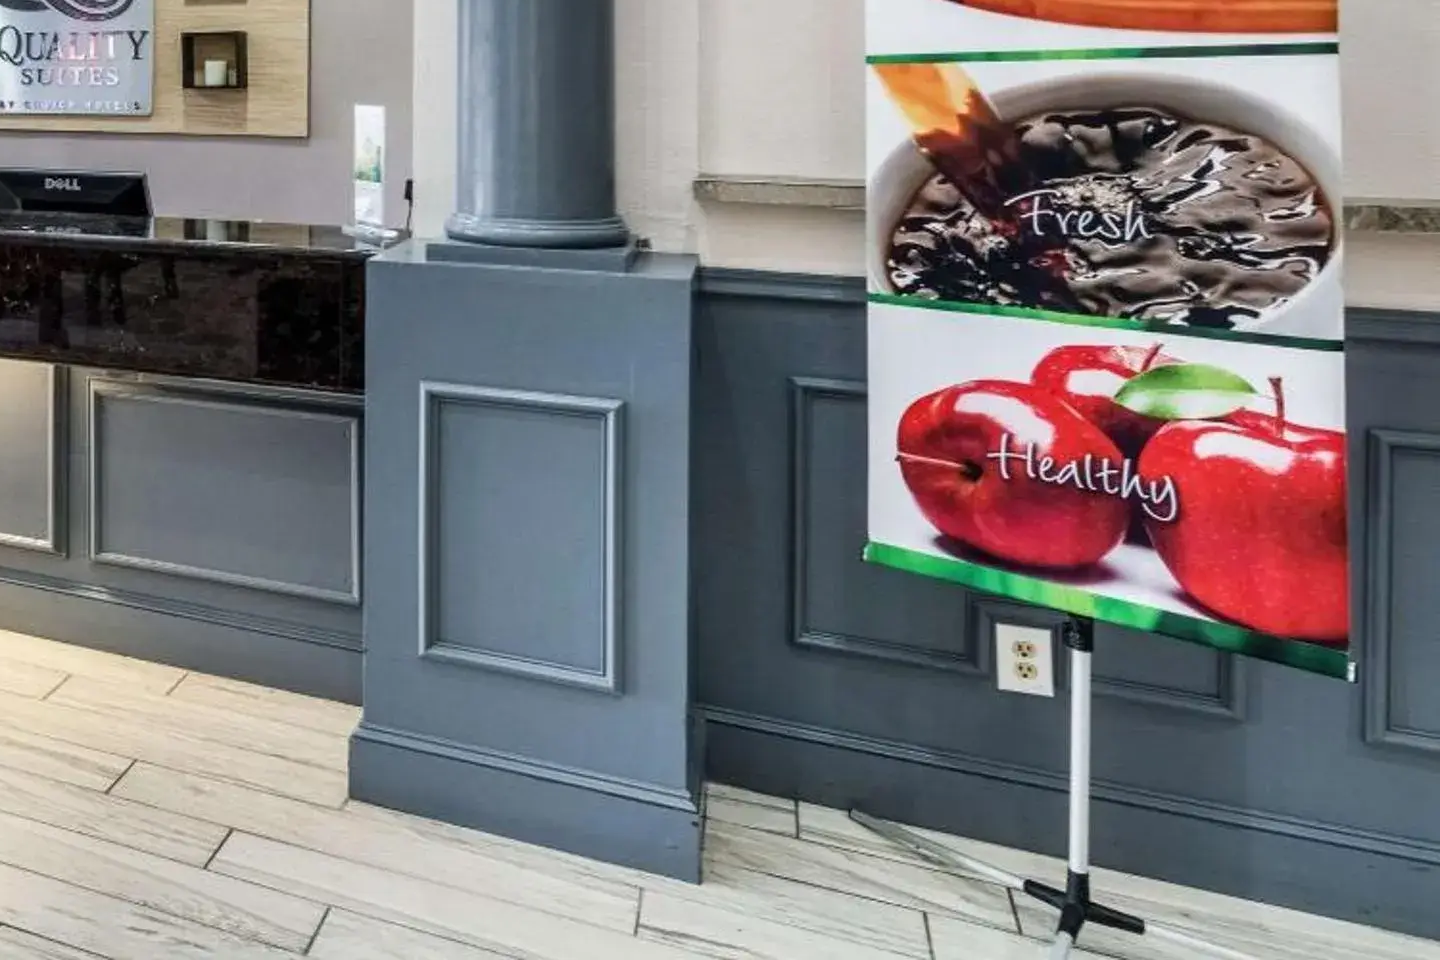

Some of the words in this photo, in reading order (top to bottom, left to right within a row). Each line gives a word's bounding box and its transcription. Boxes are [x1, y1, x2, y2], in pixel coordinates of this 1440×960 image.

[21, 66, 119, 86] SUITES
[44, 178, 81, 190] DELL
[1004, 189, 1154, 241] Fresh
[986, 432, 1178, 521] Healthy
